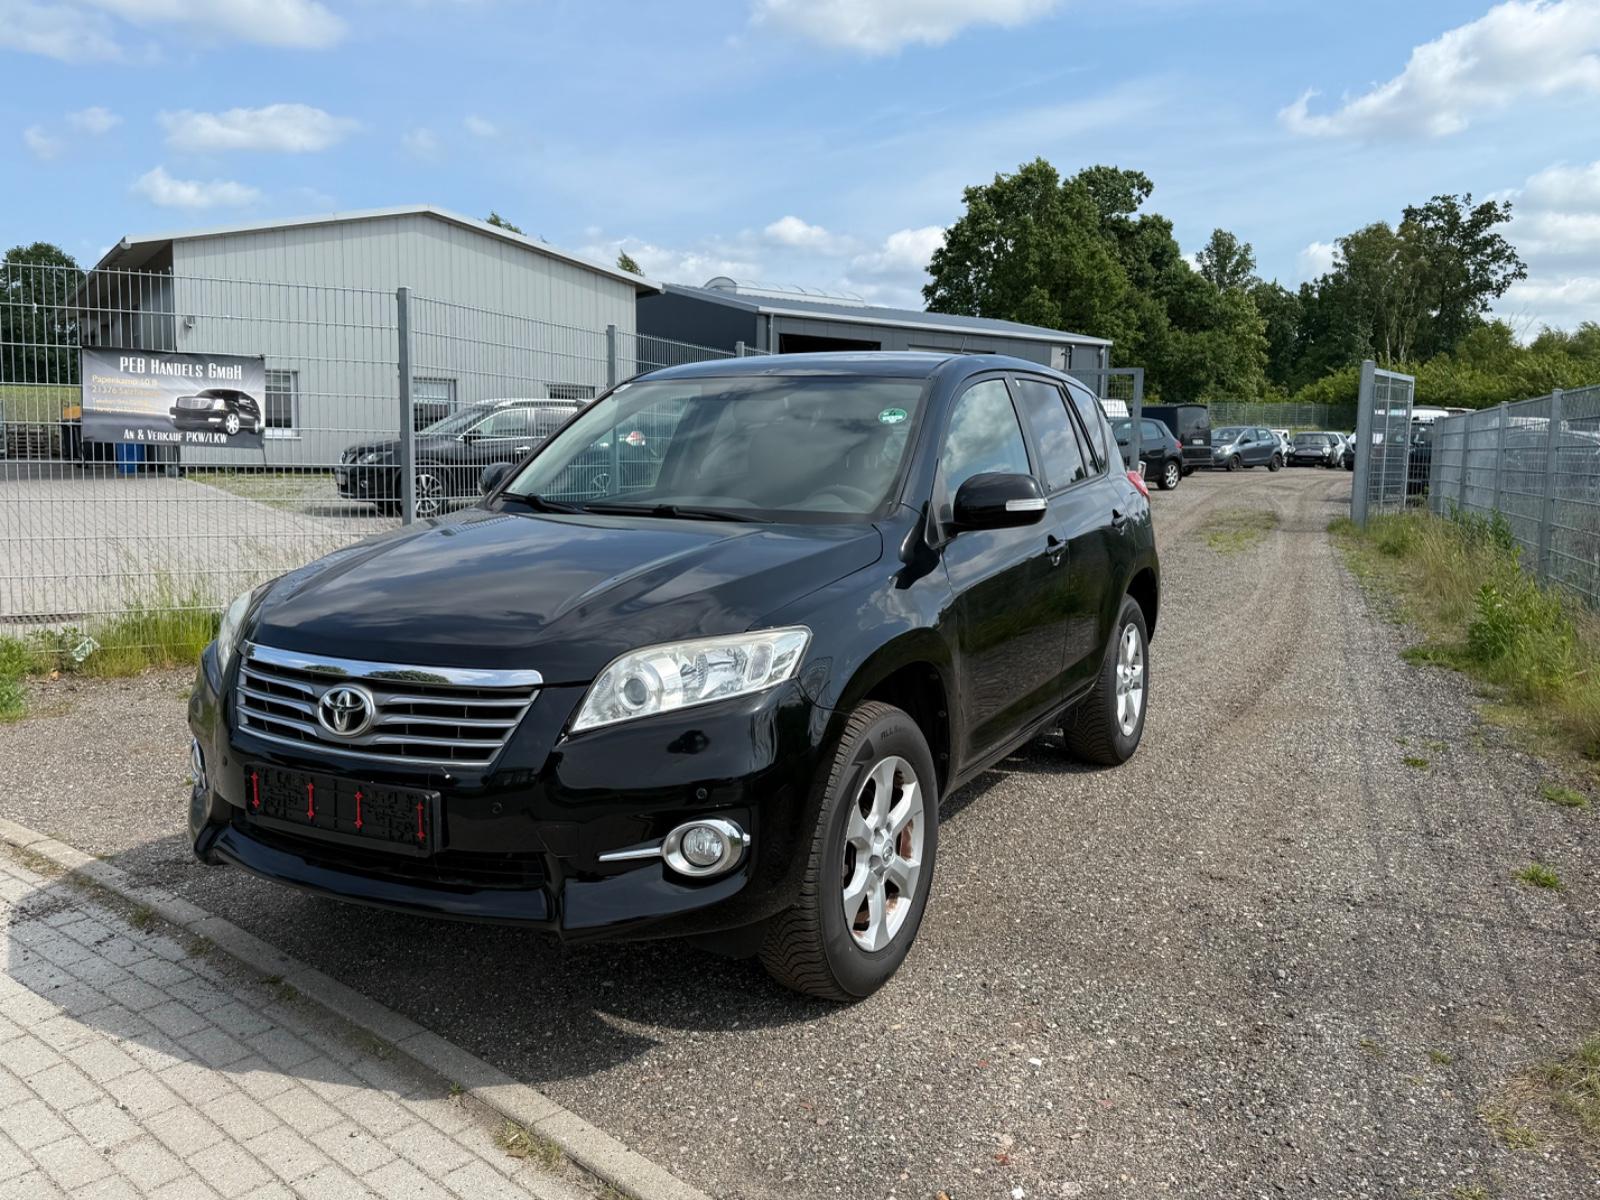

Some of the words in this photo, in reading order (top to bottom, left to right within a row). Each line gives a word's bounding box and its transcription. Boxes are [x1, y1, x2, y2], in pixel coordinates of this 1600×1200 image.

[119, 356, 146, 373] PEB
[138, 430, 144, 440] &
[186, 431, 228, 444] PKW/LKW
